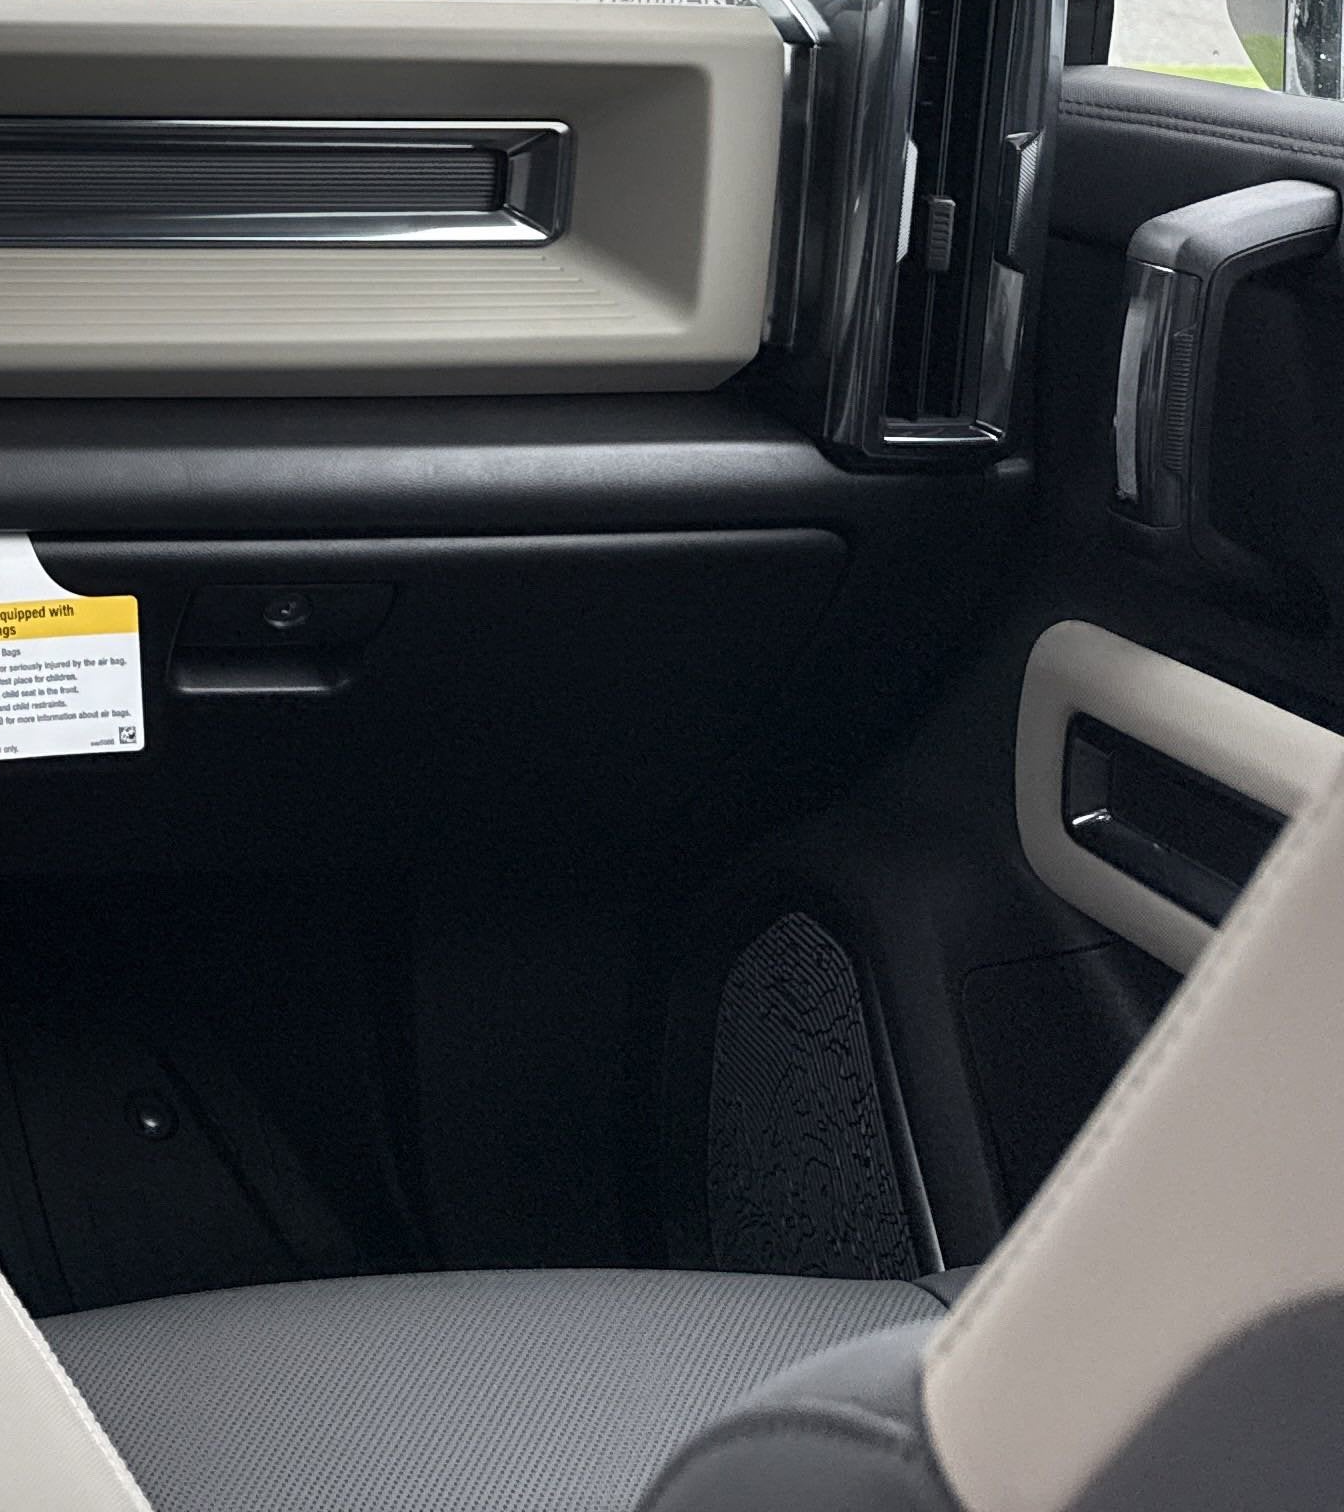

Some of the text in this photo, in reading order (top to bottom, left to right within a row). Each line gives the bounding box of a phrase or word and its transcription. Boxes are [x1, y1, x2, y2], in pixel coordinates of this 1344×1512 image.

[49, 604, 74, 617] with
[1, 648, 21, 658] Bags
[9, 662, 42, 673] seriously
[44, 660, 71, 670] injured
[72, 660, 81, 669] by
[84, 659, 96, 667] the
[110, 657, 127, 667] bag.
[14, 676, 33, 686] place
[34, 675, 44, 683] for
[2, 690, 19, 698] child
[5, 717, 15, 725] for
[37, 713, 77, 722] information
[78, 710, 99, 719] about
[4, 745, 19, 753] only.
